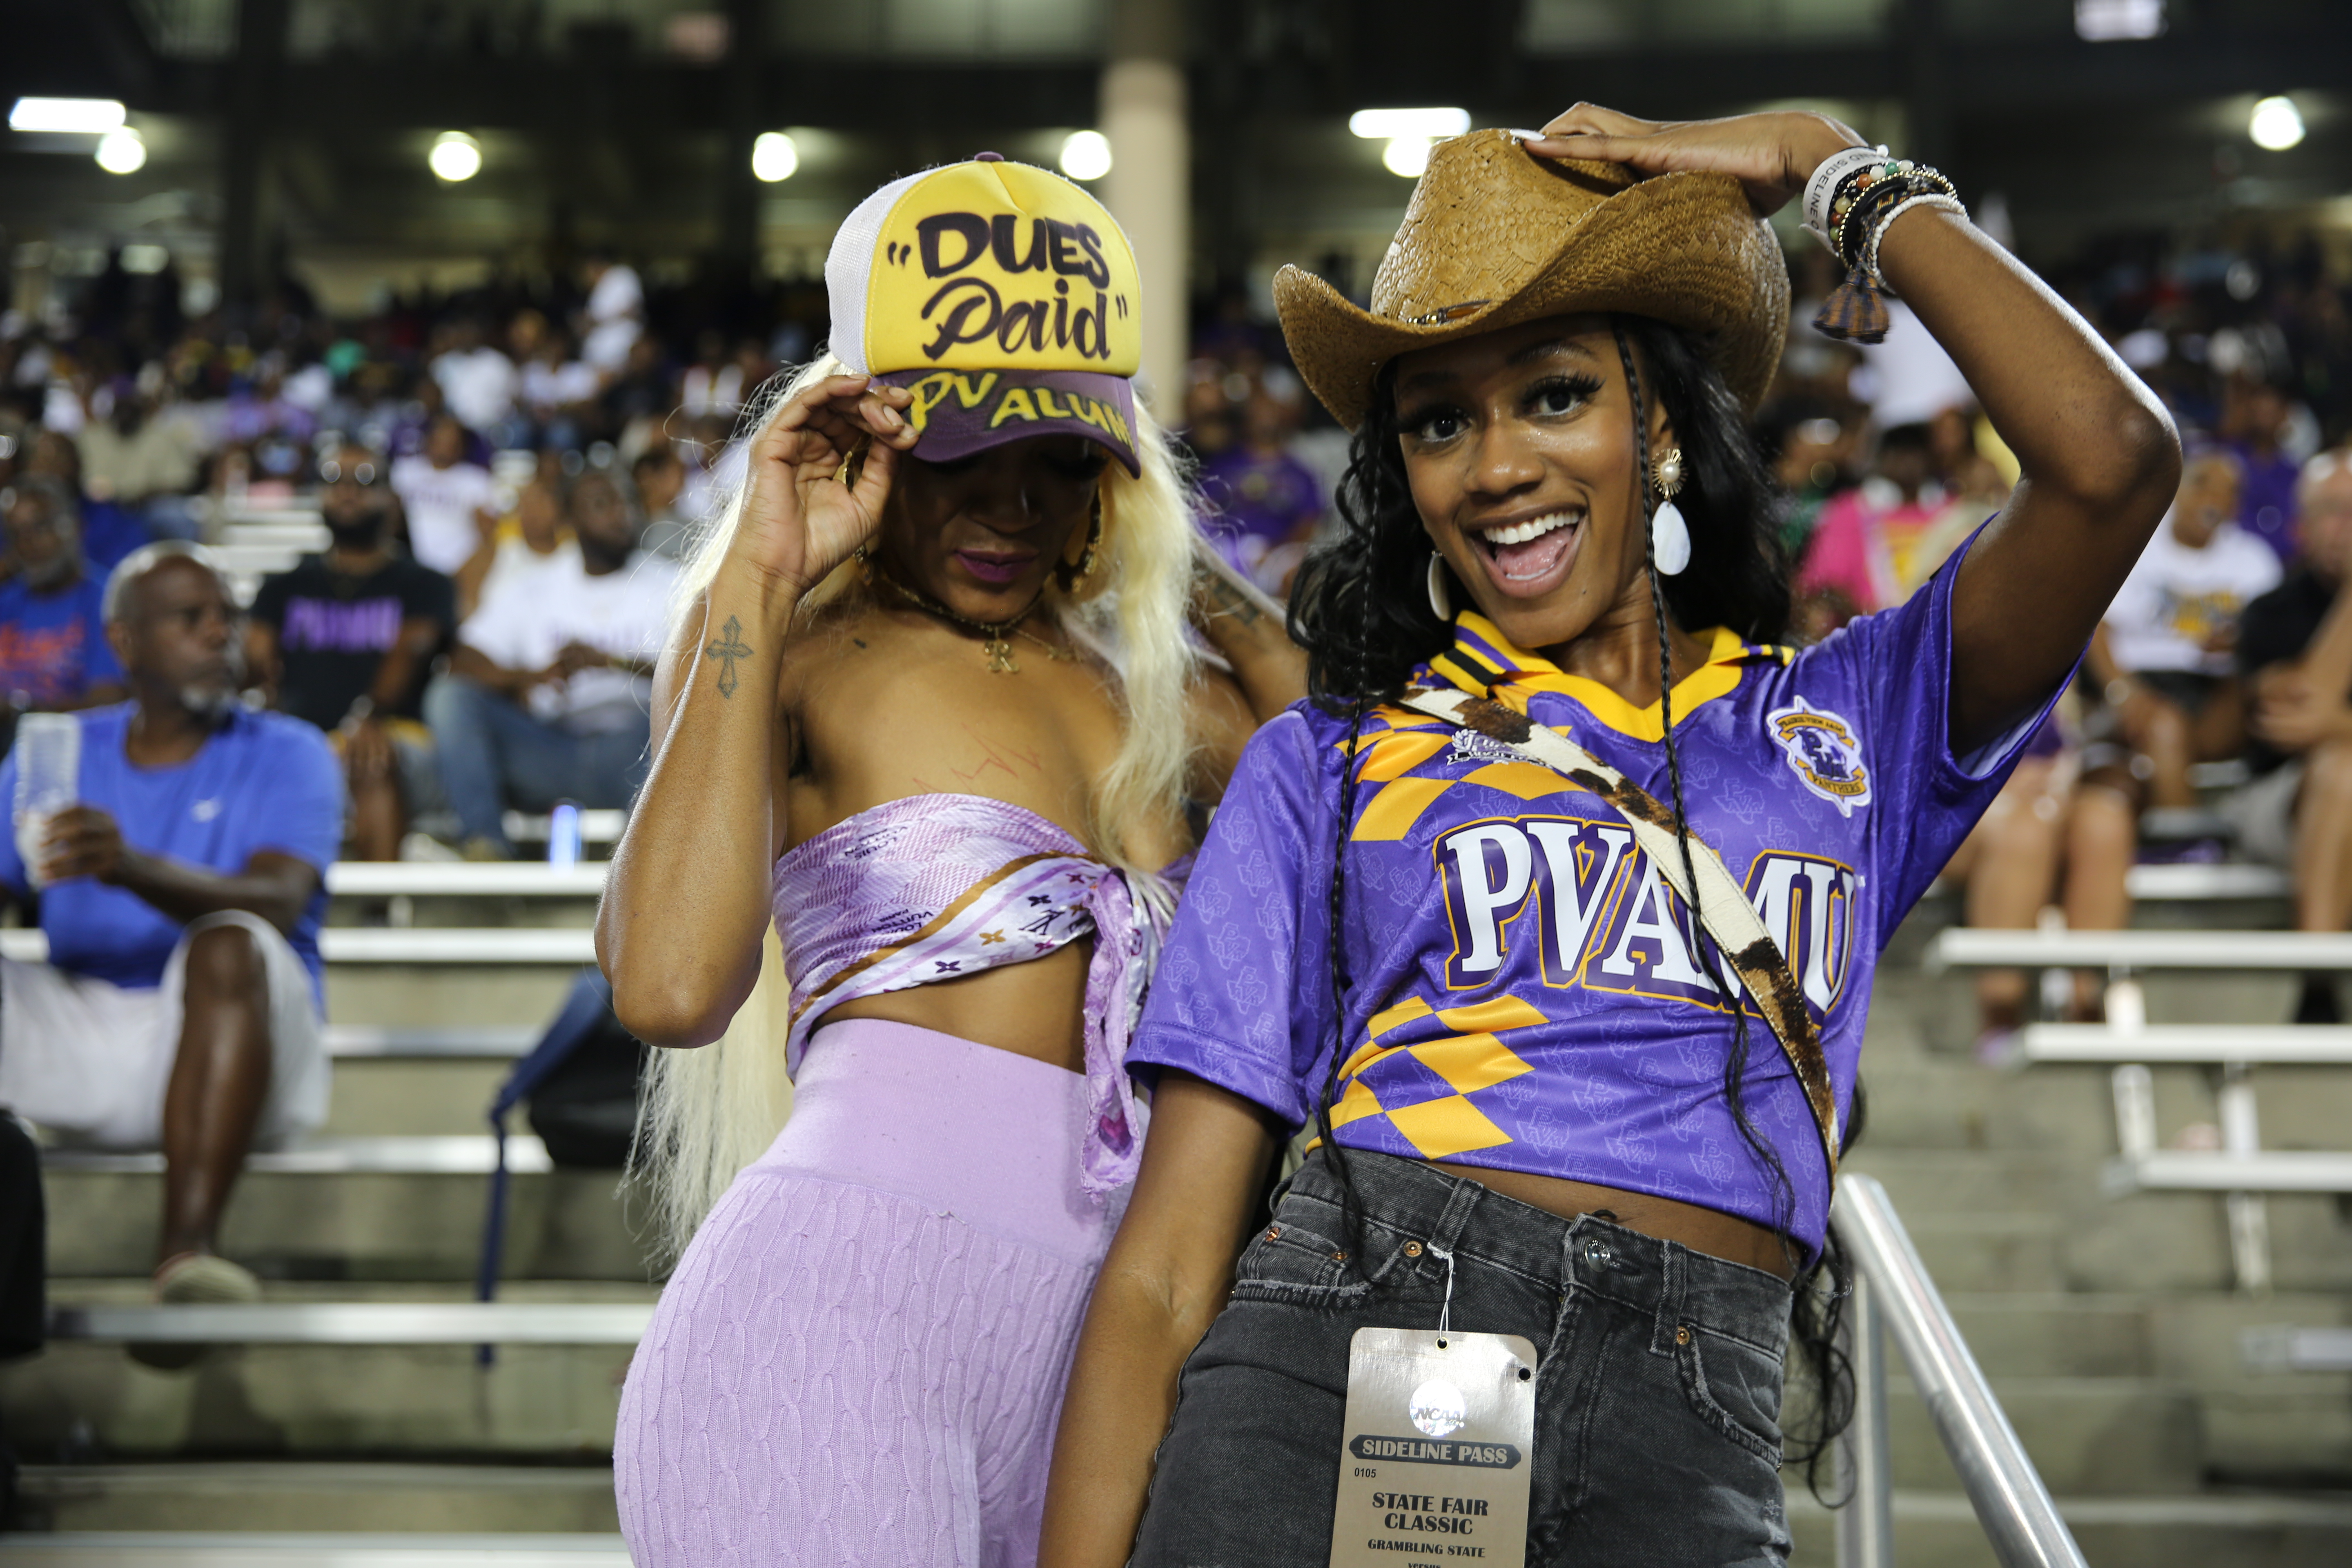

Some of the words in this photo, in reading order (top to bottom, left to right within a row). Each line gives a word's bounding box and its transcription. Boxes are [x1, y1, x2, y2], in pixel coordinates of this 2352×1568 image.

[1810, 159, 1848, 217] SIDELINE
[907, 372, 1000, 434] PV
[1362, 1439, 1452, 1461] SIDELINE
[1459, 1446, 1508, 1464] PASS
[1354, 1468, 1376, 1478] 0105
[1372, 1492, 1434, 1512] STATE
[1441, 1497, 1488, 1516] FAIR
[1384, 1512, 1473, 1535] CLASSIC
[1368, 1539, 1443, 1555] GRAMBLING
[1447, 1545, 1486, 1558] STATE
